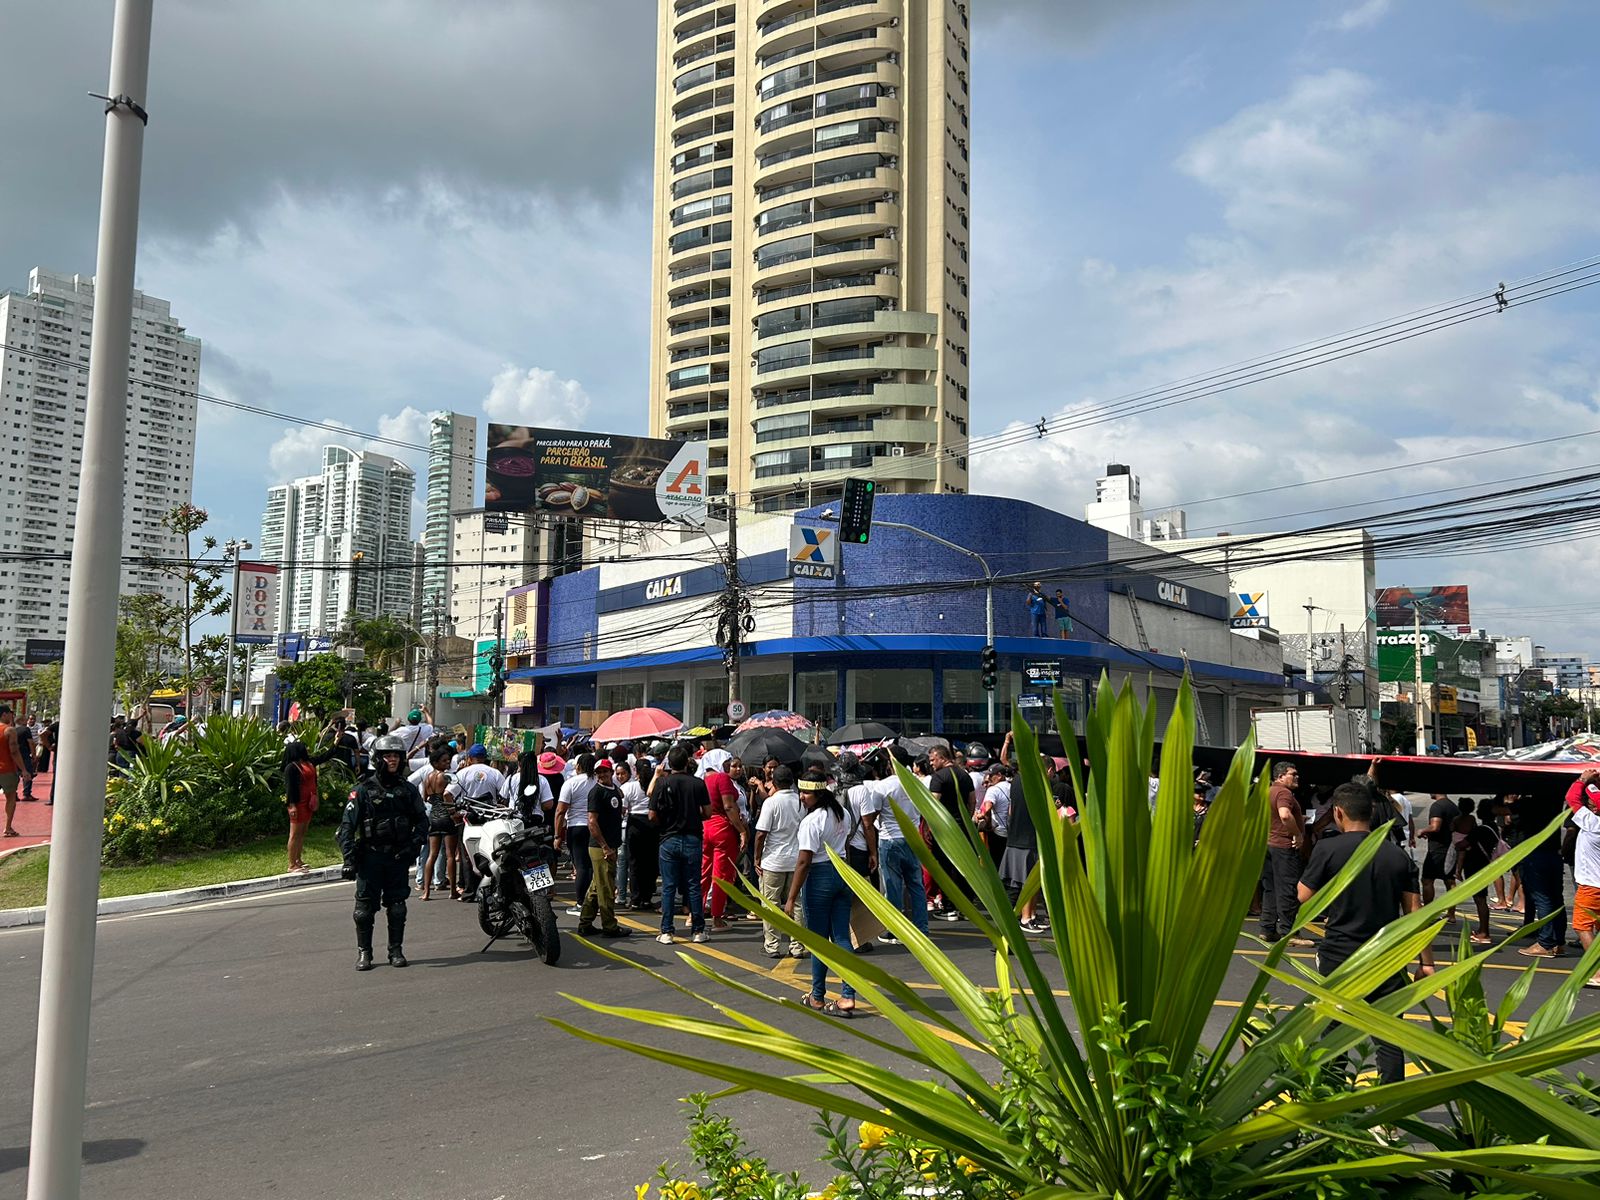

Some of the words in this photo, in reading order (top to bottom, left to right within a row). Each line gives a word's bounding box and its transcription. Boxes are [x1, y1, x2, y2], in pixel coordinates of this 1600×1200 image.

[546, 447, 590, 456] PARCEIRÃO
[540, 456, 561, 465] PARA
[562, 457, 569, 465] O
[794, 564, 832, 577] CAIXA
[645, 576, 682, 600] CAIXA
[1158, 581, 1187, 606] CAIXA
[252, 575, 268, 631] DOCA
[1233, 618, 1266, 627] CAIXA
[732, 704, 742, 712] 50
[530, 871, 546, 882] SZG
[530, 877, 551, 889] 7E13
